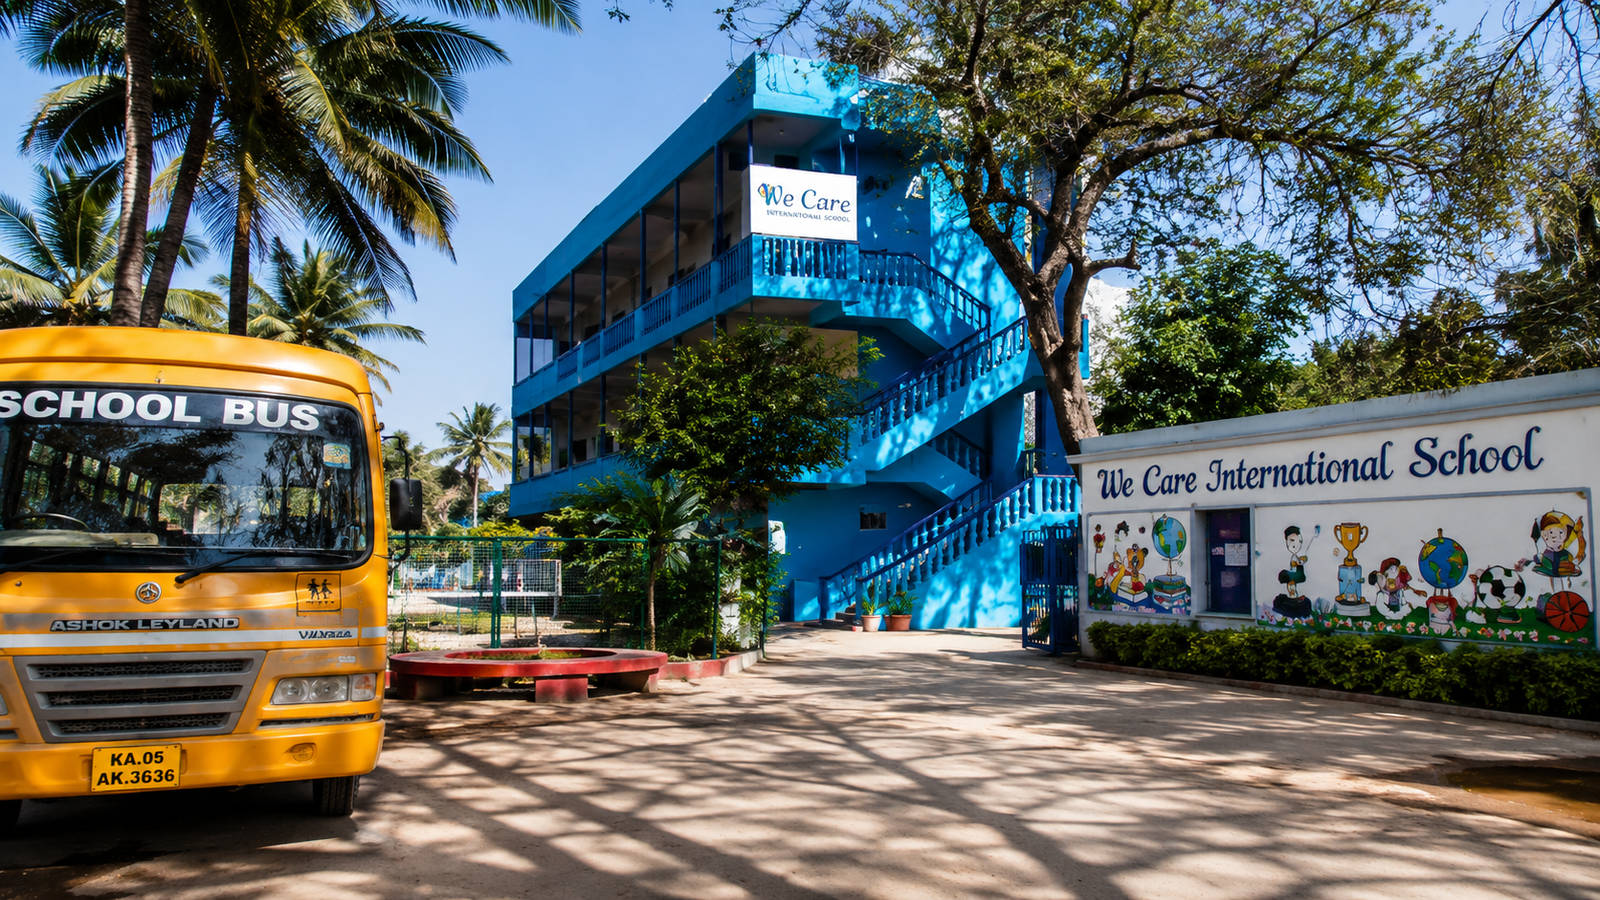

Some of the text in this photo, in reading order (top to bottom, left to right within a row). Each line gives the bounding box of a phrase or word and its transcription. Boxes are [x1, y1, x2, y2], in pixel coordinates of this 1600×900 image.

[757, 183, 851, 213] We Care
[0, 390, 320, 431] SCHOOL BUS
[1097, 426, 1544, 499] We Care International School
[51, 618, 239, 631] ASHOK LEYLAND
[110, 751, 164, 766] KA.05
[96, 769, 175, 786] AK.3636
